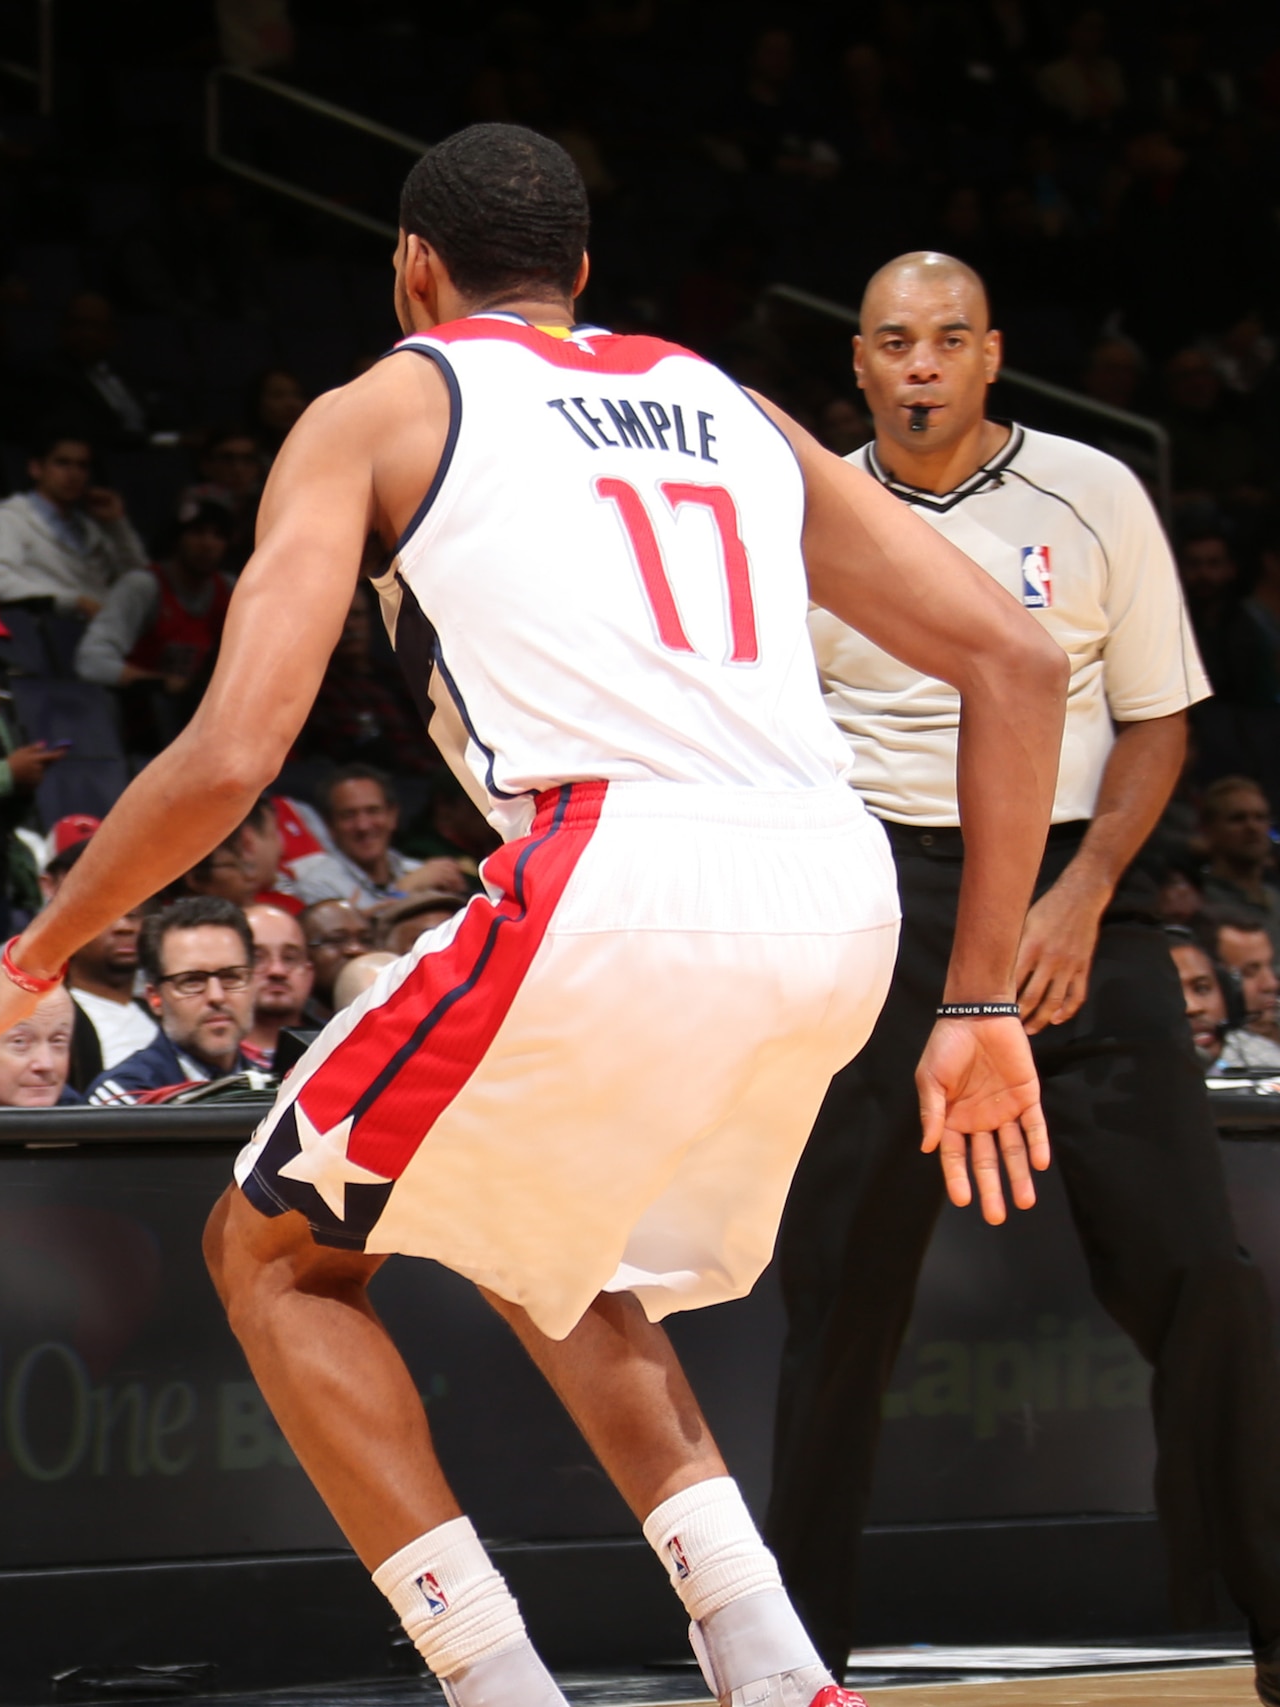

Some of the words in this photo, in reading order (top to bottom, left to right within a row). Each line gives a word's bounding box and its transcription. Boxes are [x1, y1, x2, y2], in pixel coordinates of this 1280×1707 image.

[546, 397, 719, 465] TEMPLE
[590, 474, 762, 668] 17
[983, 1005, 1012, 1013] NAME
[881, 1313, 1155, 1438] apita
